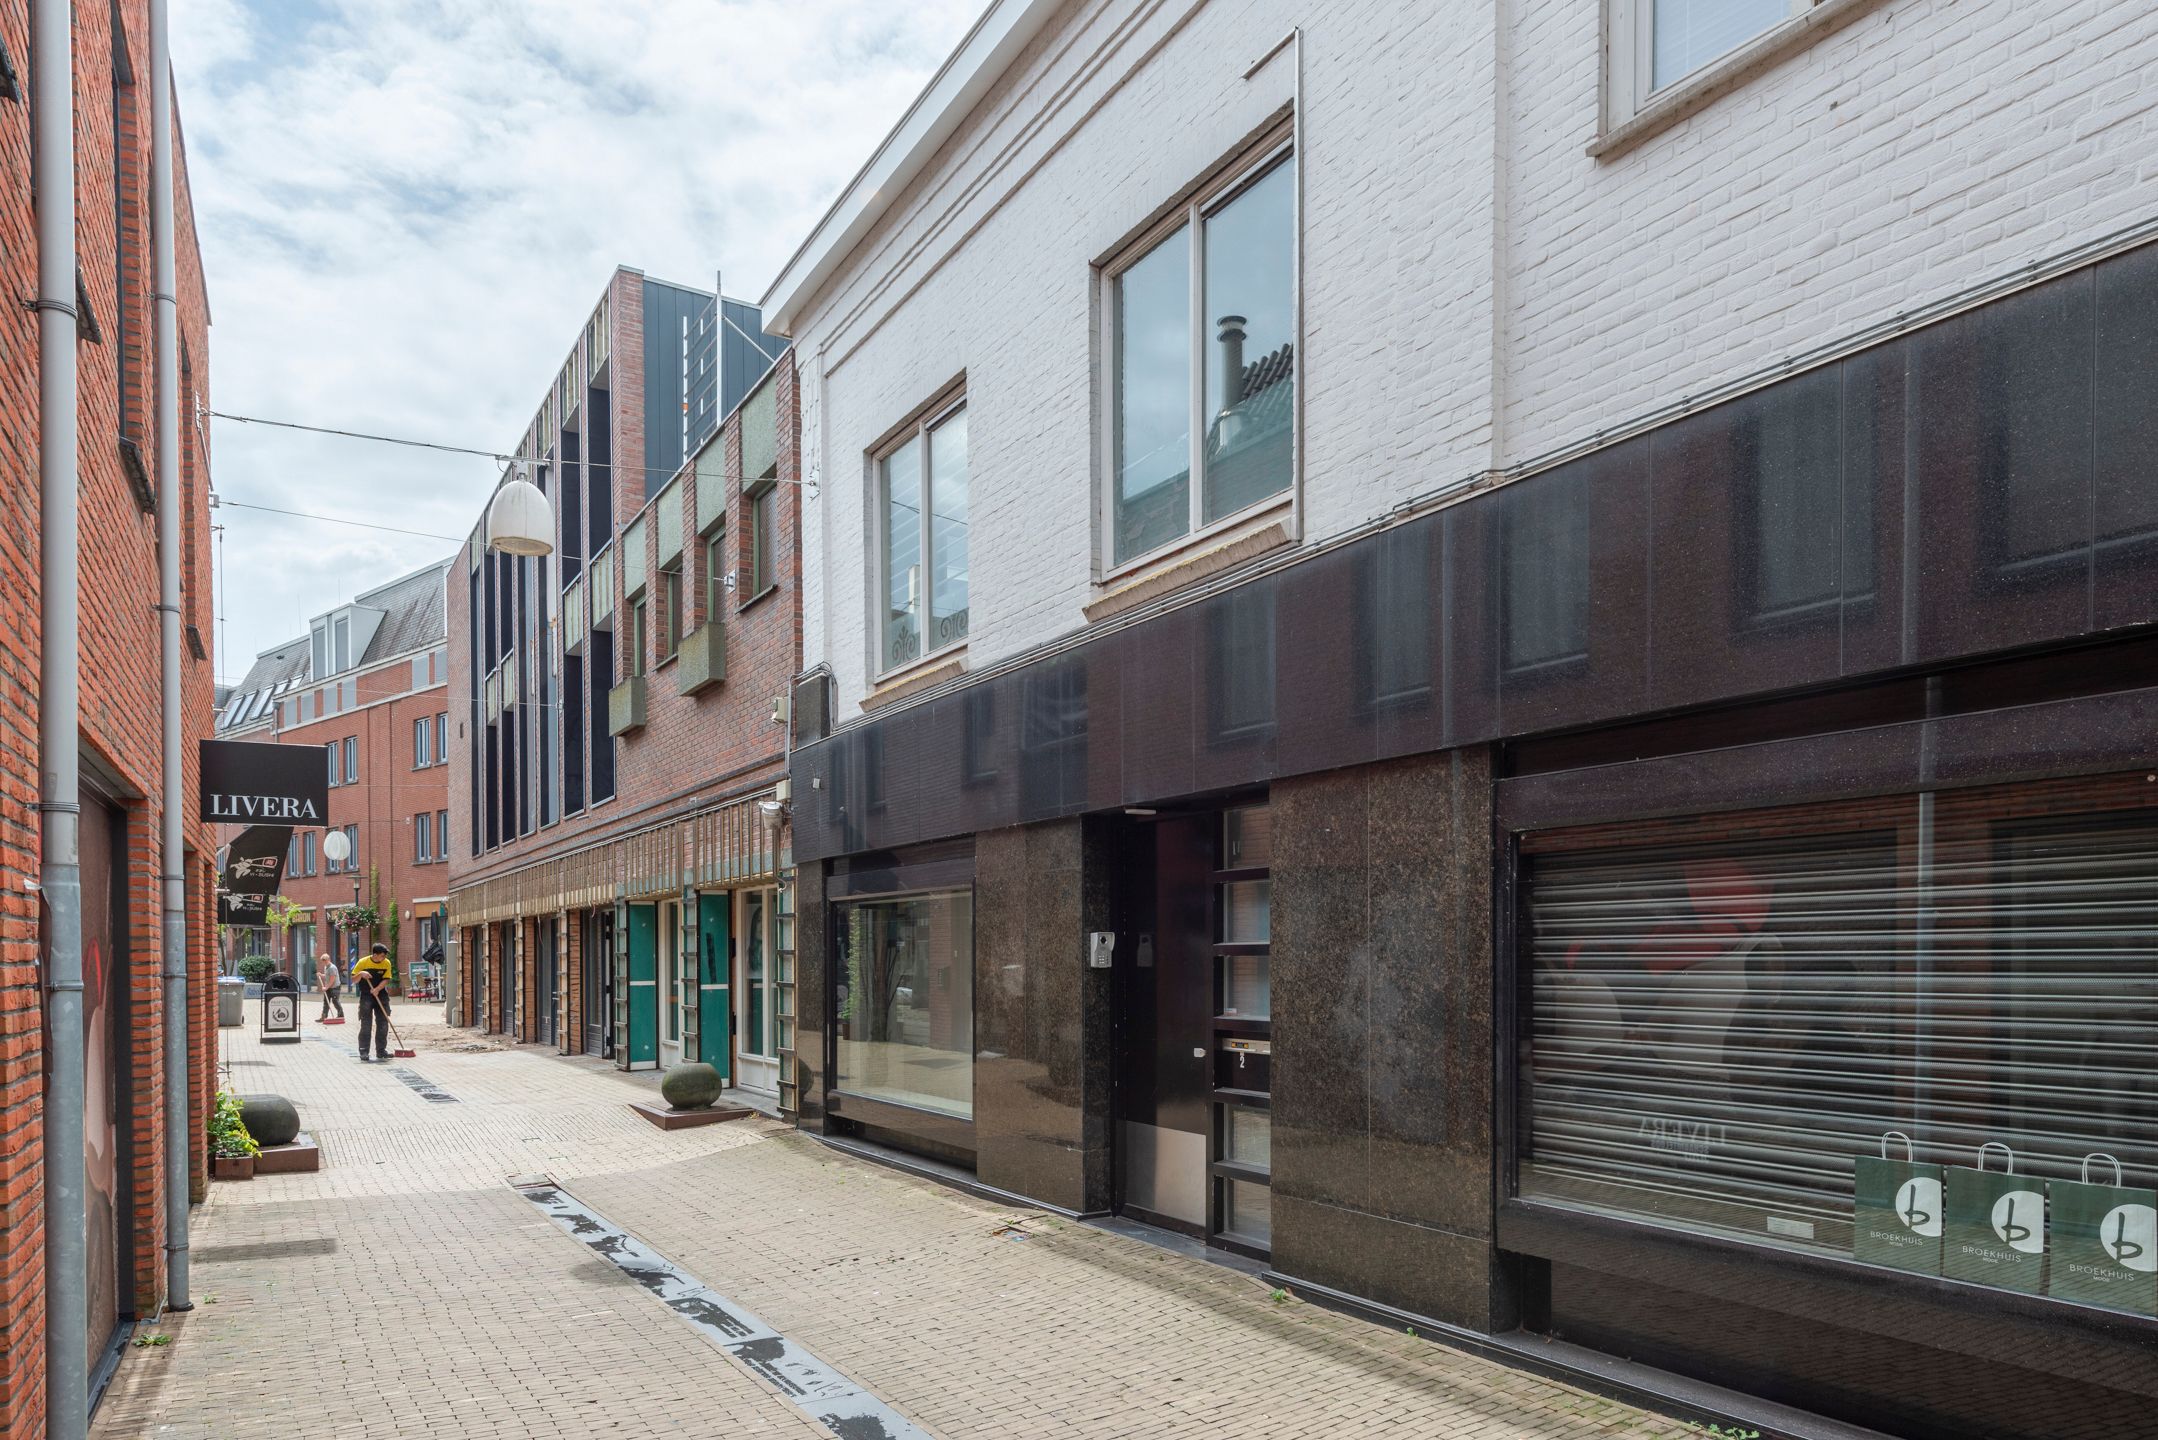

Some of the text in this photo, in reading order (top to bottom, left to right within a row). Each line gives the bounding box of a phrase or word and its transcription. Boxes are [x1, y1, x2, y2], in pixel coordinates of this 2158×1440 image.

[210, 793, 319, 819] LIVERA
[1240, 1056, 1245, 1068] 2
[1869, 1230, 1923, 1247] BROEKHUIS
[1962, 1245, 2022, 1263] BROEKHUIS
[2069, 1263, 2135, 1282] BROEKHUIS
